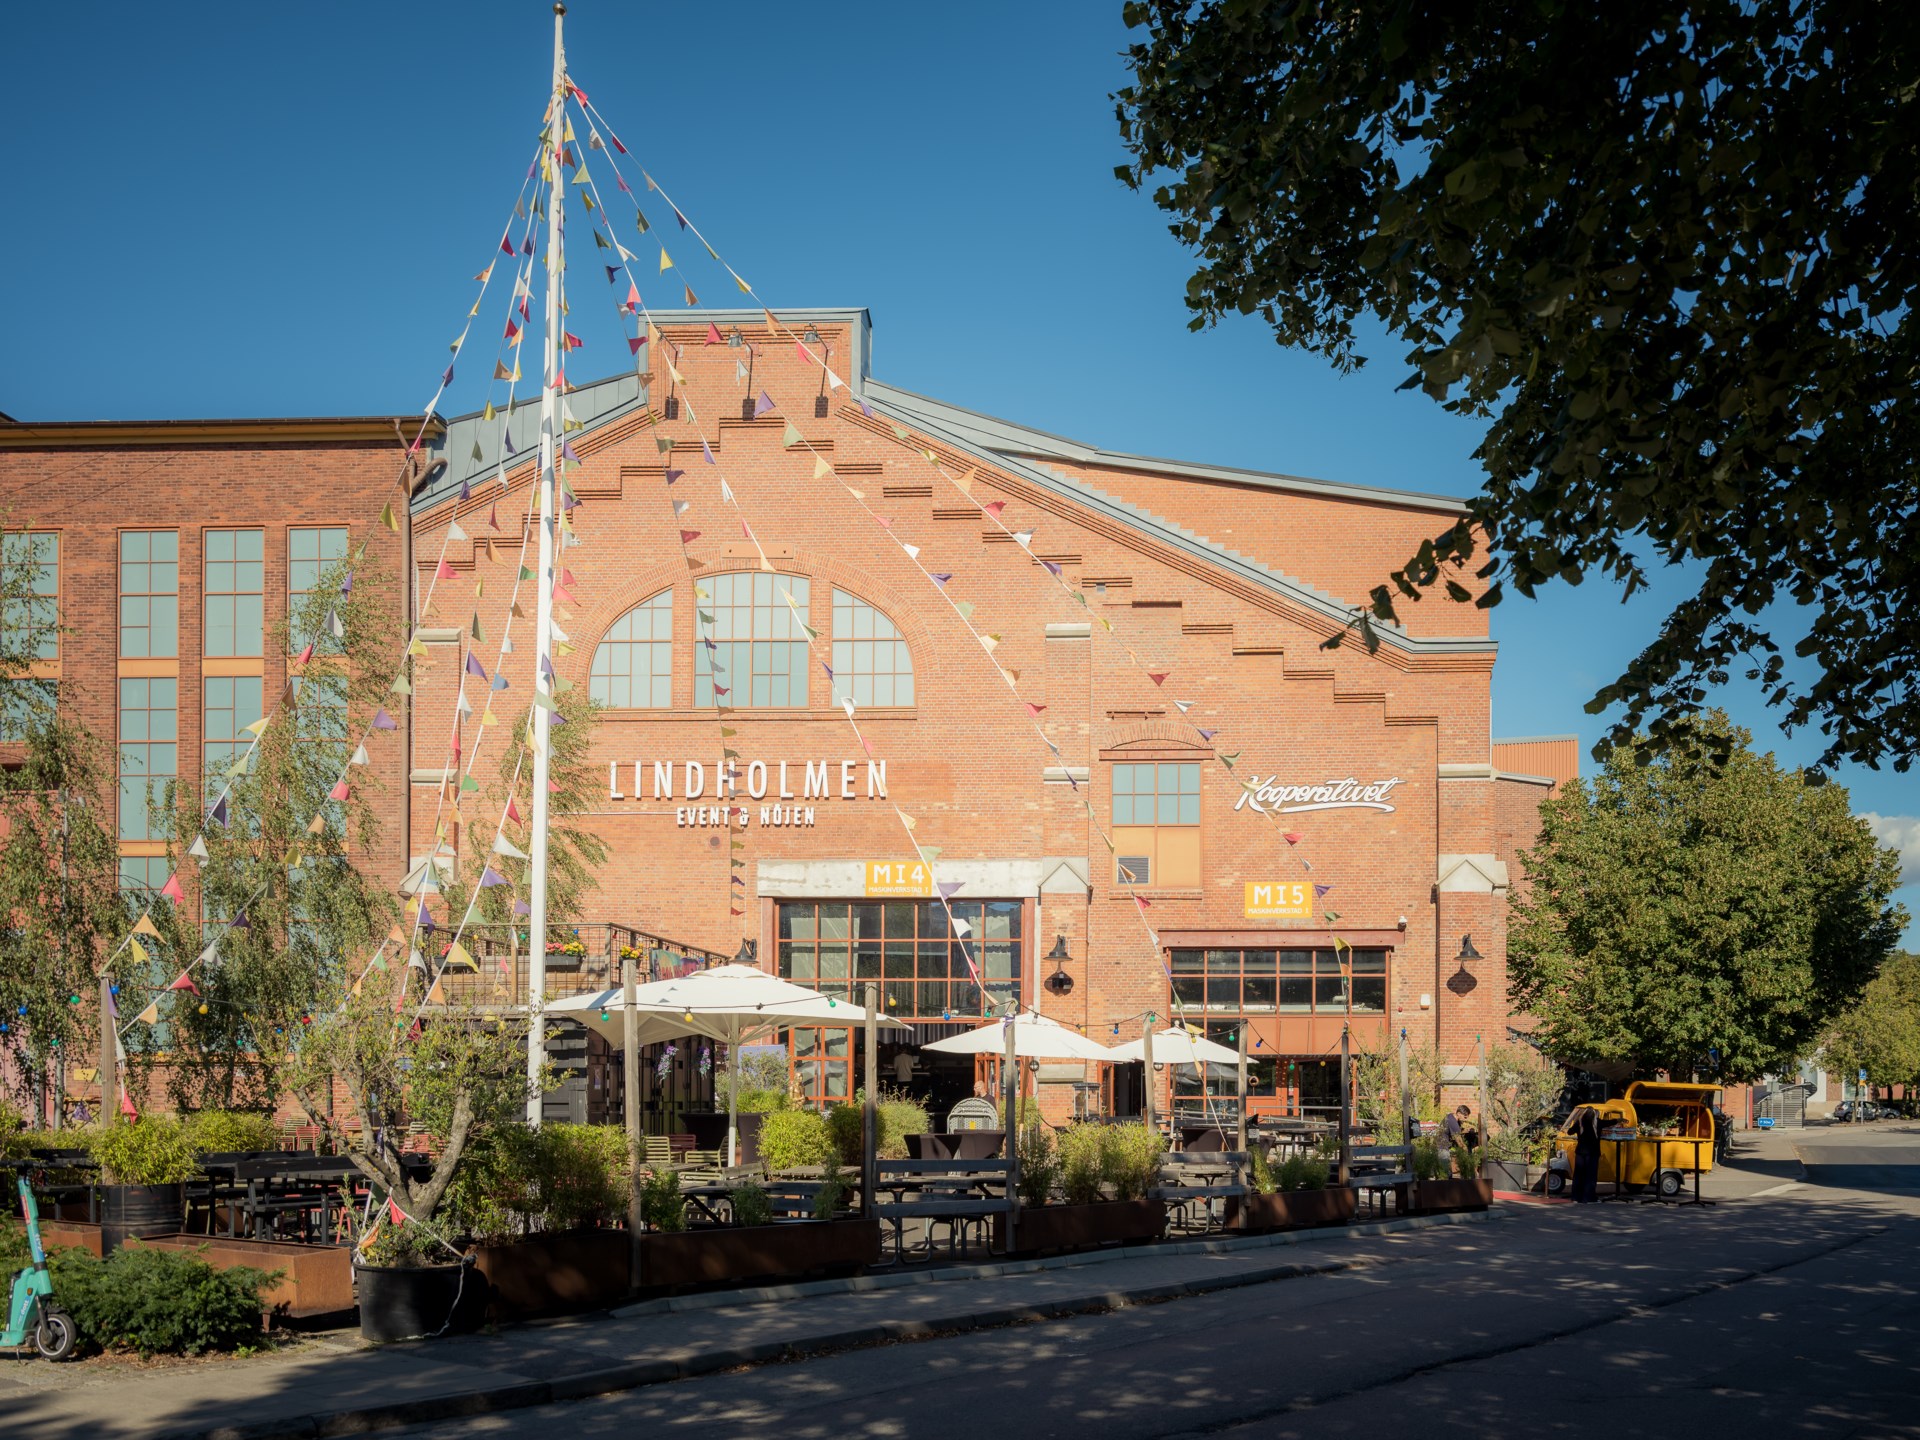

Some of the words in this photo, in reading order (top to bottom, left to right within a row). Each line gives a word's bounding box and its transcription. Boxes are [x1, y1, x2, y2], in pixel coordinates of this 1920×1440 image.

[610, 760, 887, 799] LINDHOLMEN
[1234, 775, 1406, 813] Kooperativet
[677, 807, 730, 825] EVENT
[740, 808, 749, 825] &
[760, 804, 815, 825] NÖJEN
[874, 864, 925, 884] MI4
[1254, 885, 1304, 905] MI5
